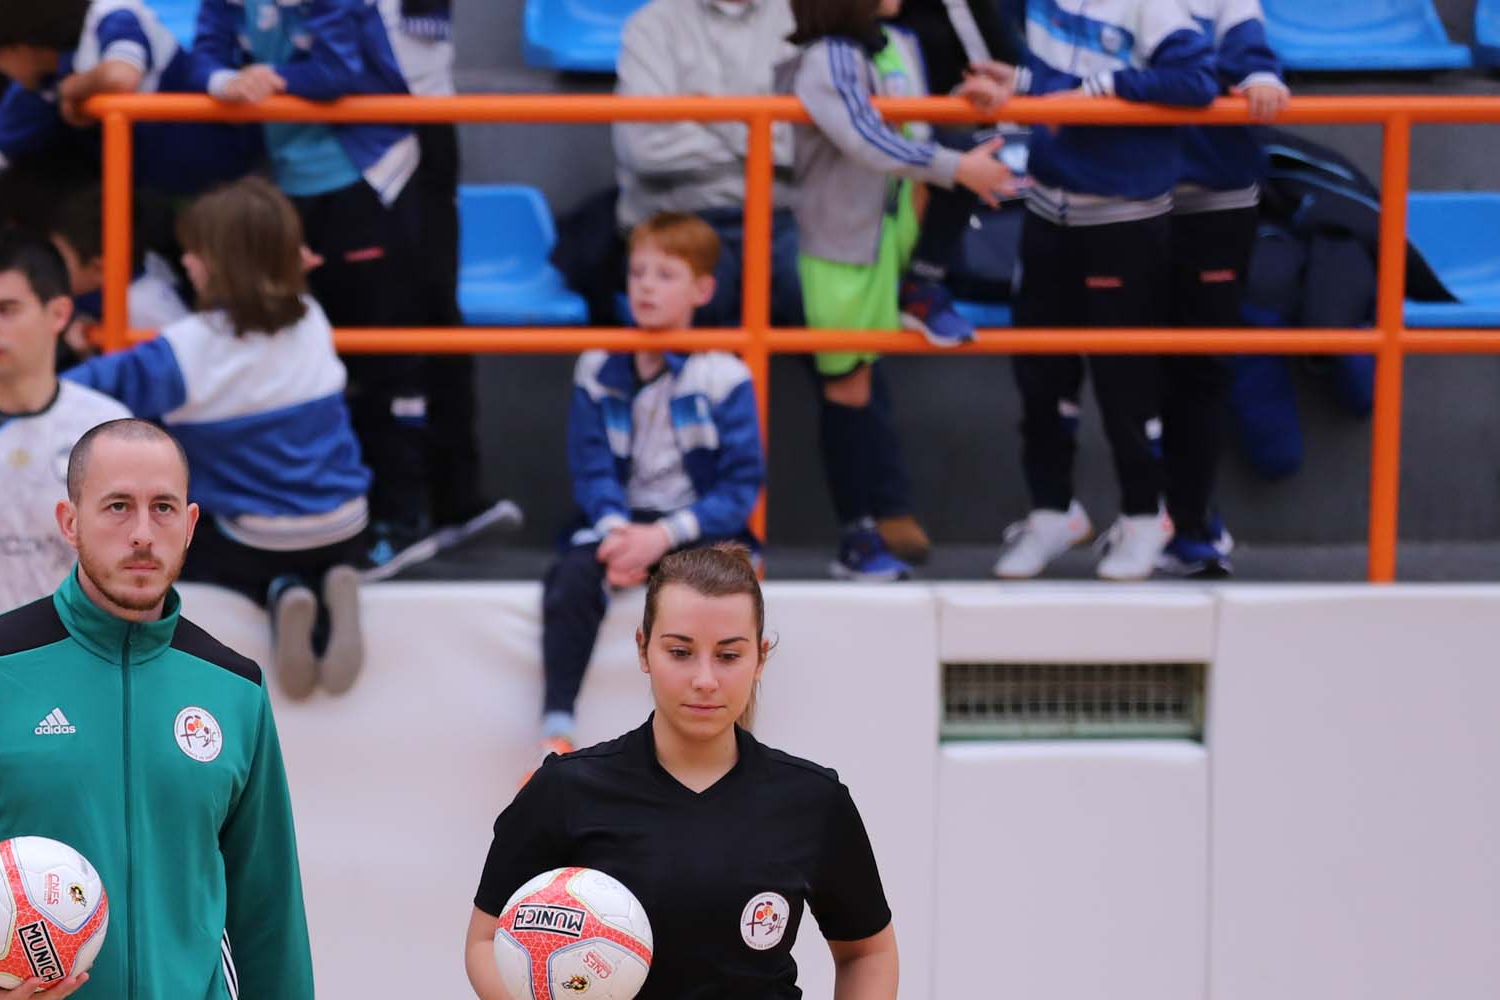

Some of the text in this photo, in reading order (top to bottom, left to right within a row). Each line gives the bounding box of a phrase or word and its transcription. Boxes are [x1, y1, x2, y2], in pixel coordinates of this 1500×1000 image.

[34, 725, 76, 735] adidas
[514, 908, 583, 931] MUNICH
[24, 922, 59, 982] MUNICH
